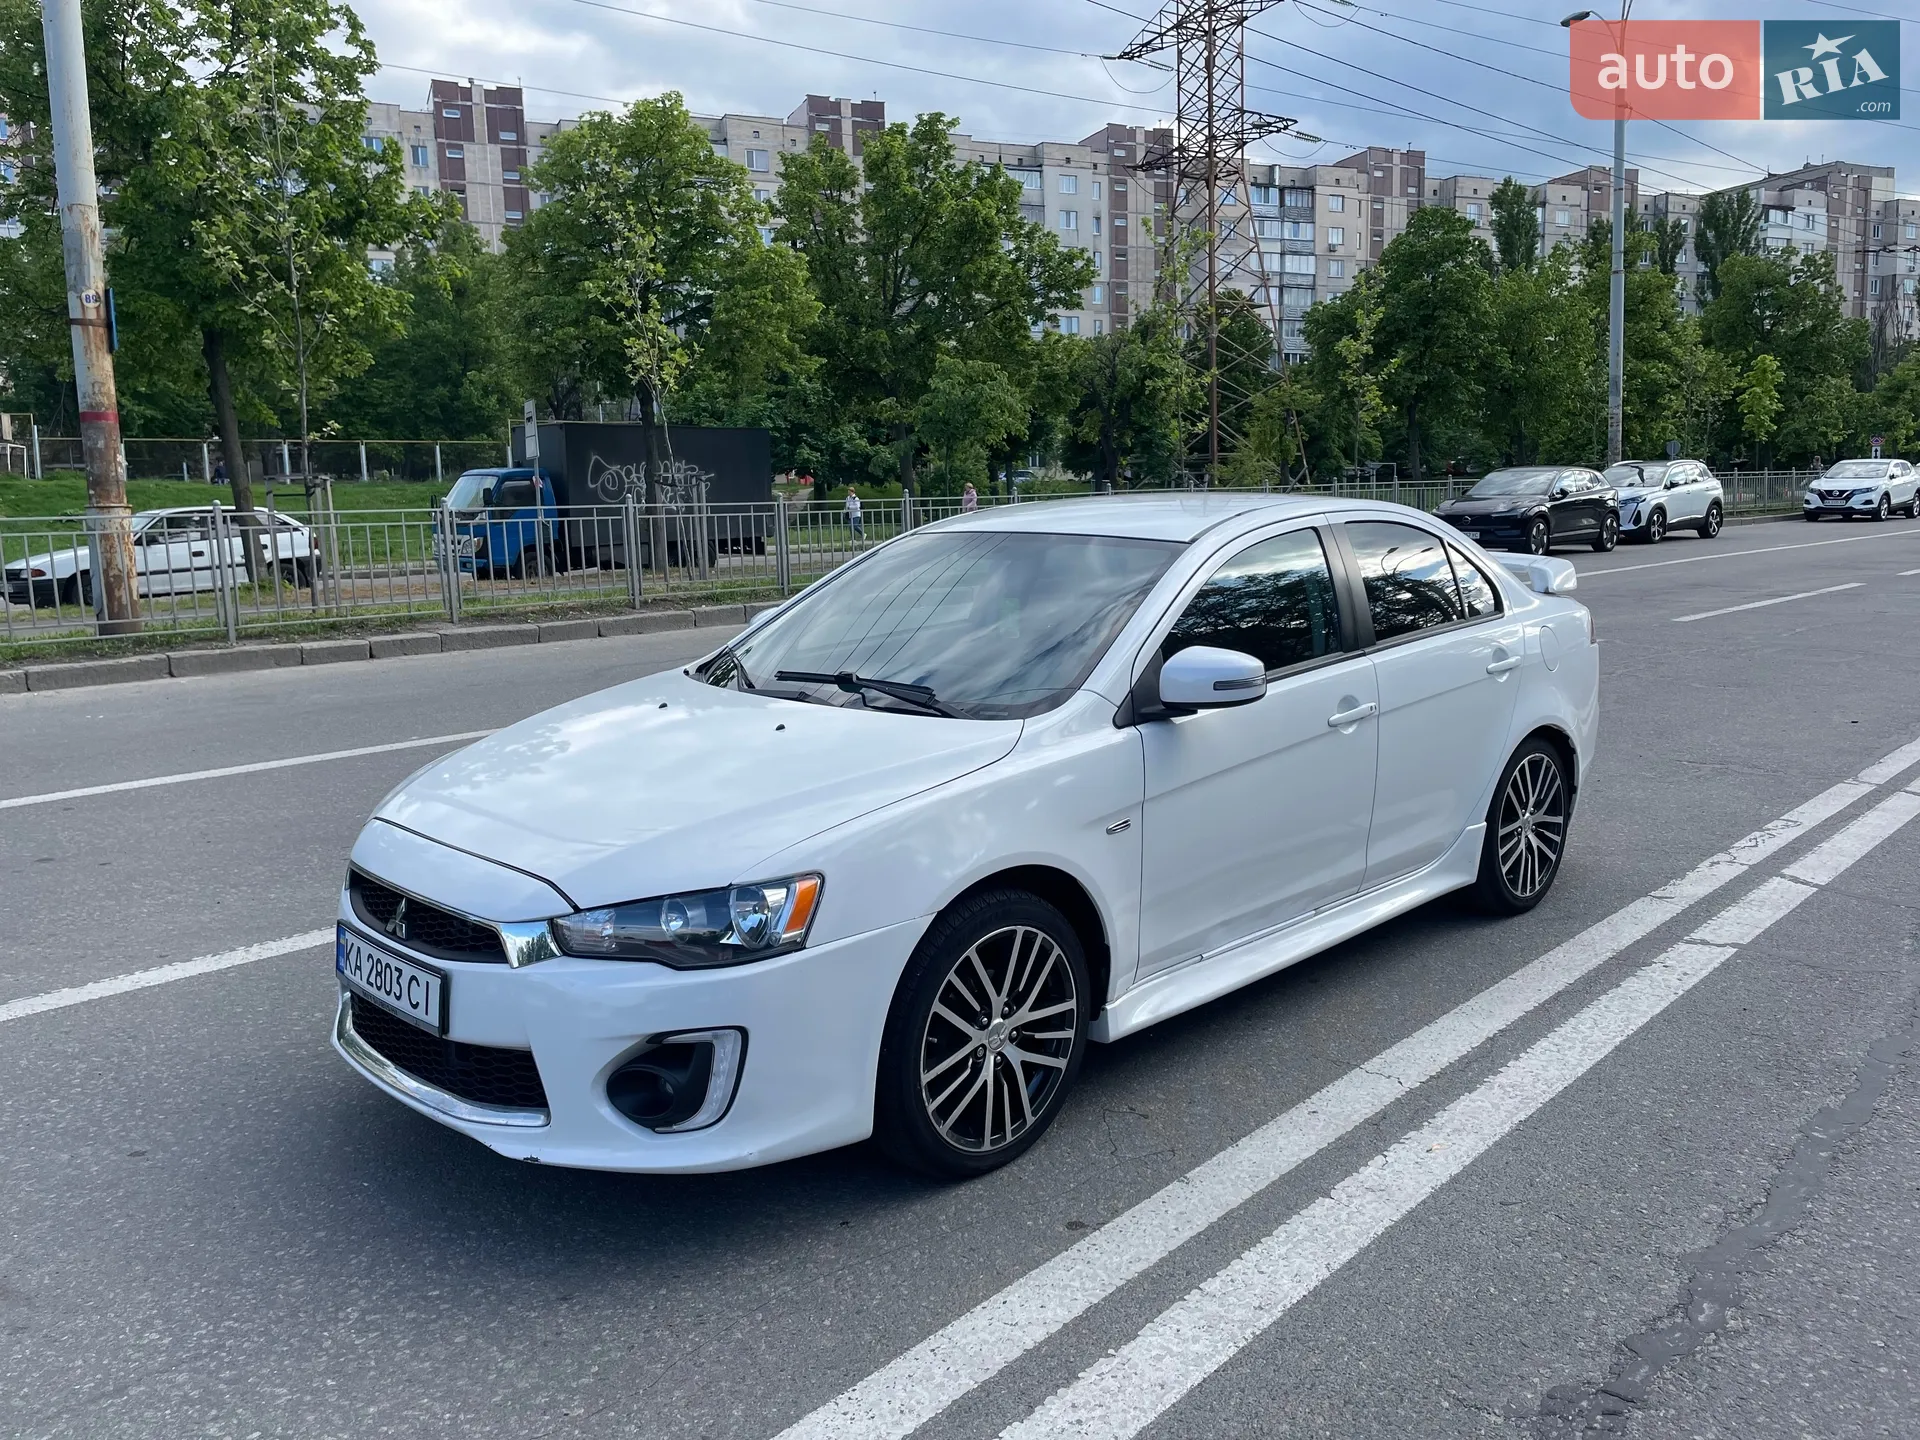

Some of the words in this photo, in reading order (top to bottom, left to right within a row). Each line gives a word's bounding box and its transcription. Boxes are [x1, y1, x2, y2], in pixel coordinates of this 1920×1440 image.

[345, 938, 363, 981] KA
[366, 953, 403, 1001] 2803
[407, 974, 429, 1016] CI
